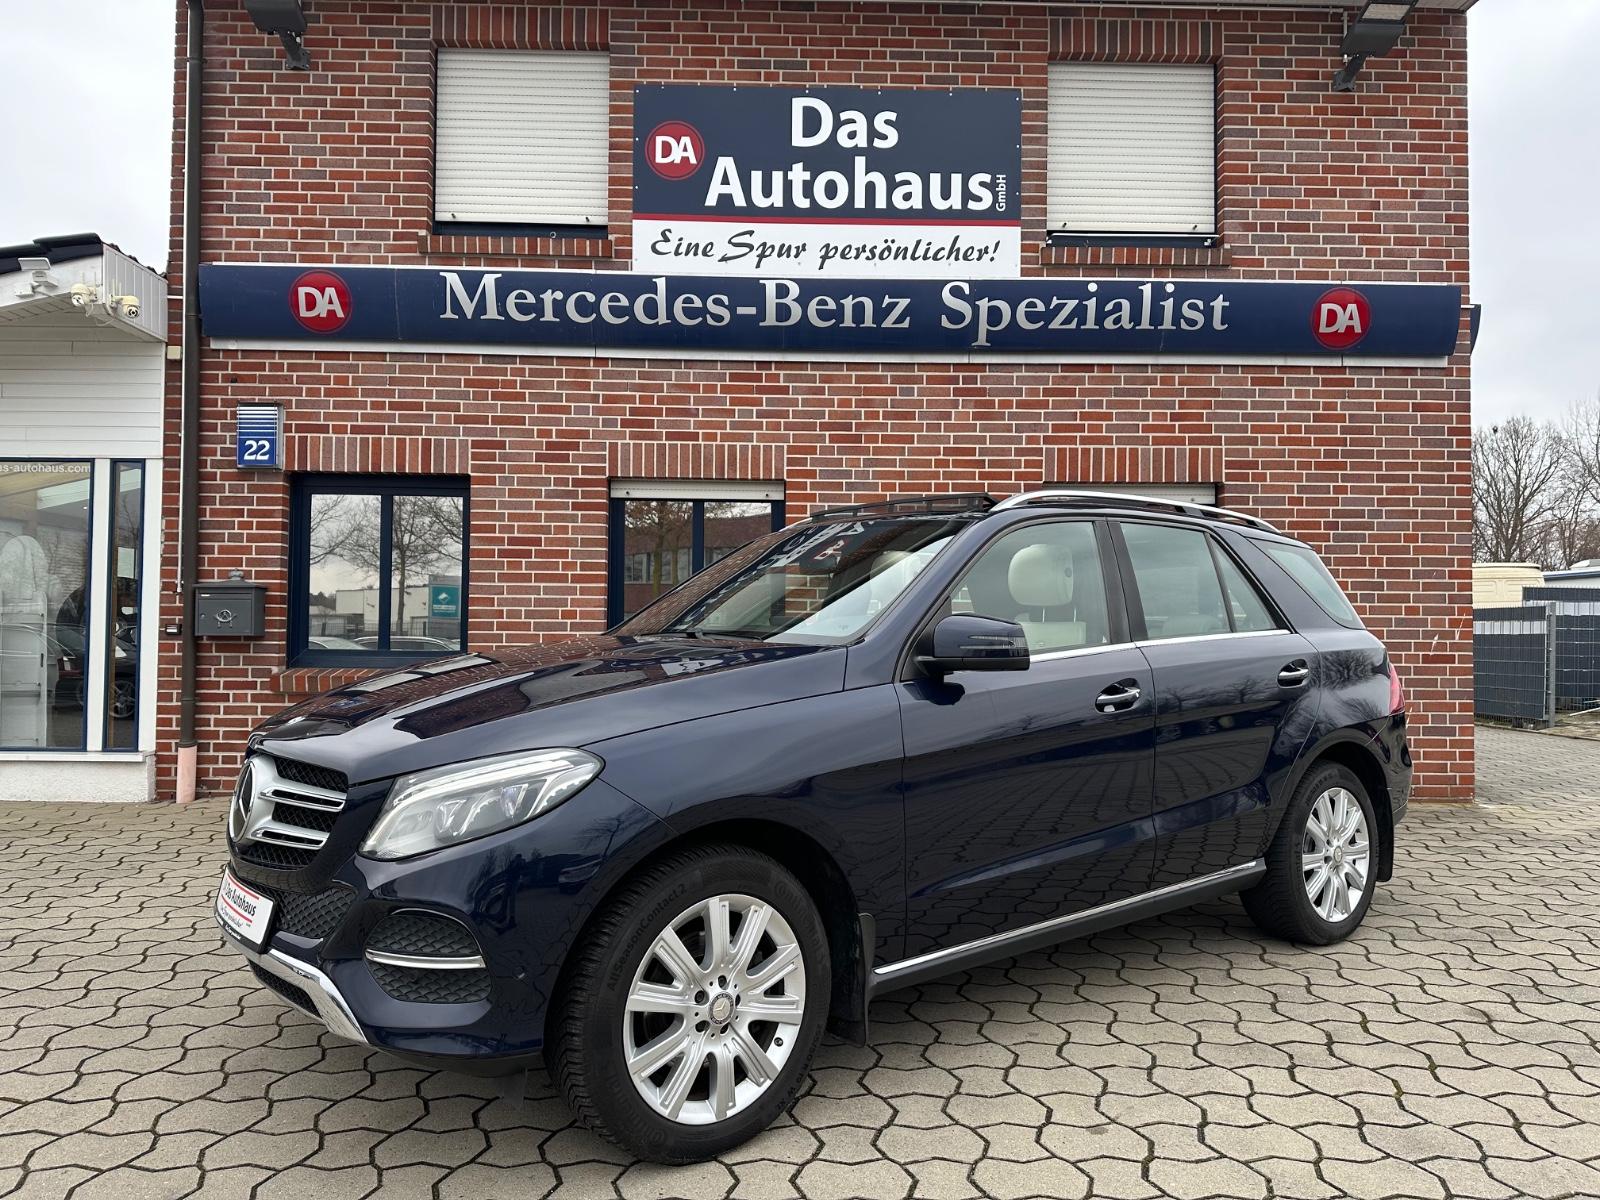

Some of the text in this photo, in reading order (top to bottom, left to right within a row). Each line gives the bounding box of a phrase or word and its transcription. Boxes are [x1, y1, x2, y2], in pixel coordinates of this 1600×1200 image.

[791, 96, 899, 149] Das
[654, 135, 698, 165] DA
[703, 156, 994, 211] Autohaus
[995, 174, 1007, 212] GmbH
[650, 228, 1001, 270] Eine Spur persönlicher!
[297, 286, 344, 318] DA
[439, 271, 1230, 347] Mercedes-Benz Spezialist
[1319, 303, 1362, 333] DA
[243, 439, 270, 461] 22
